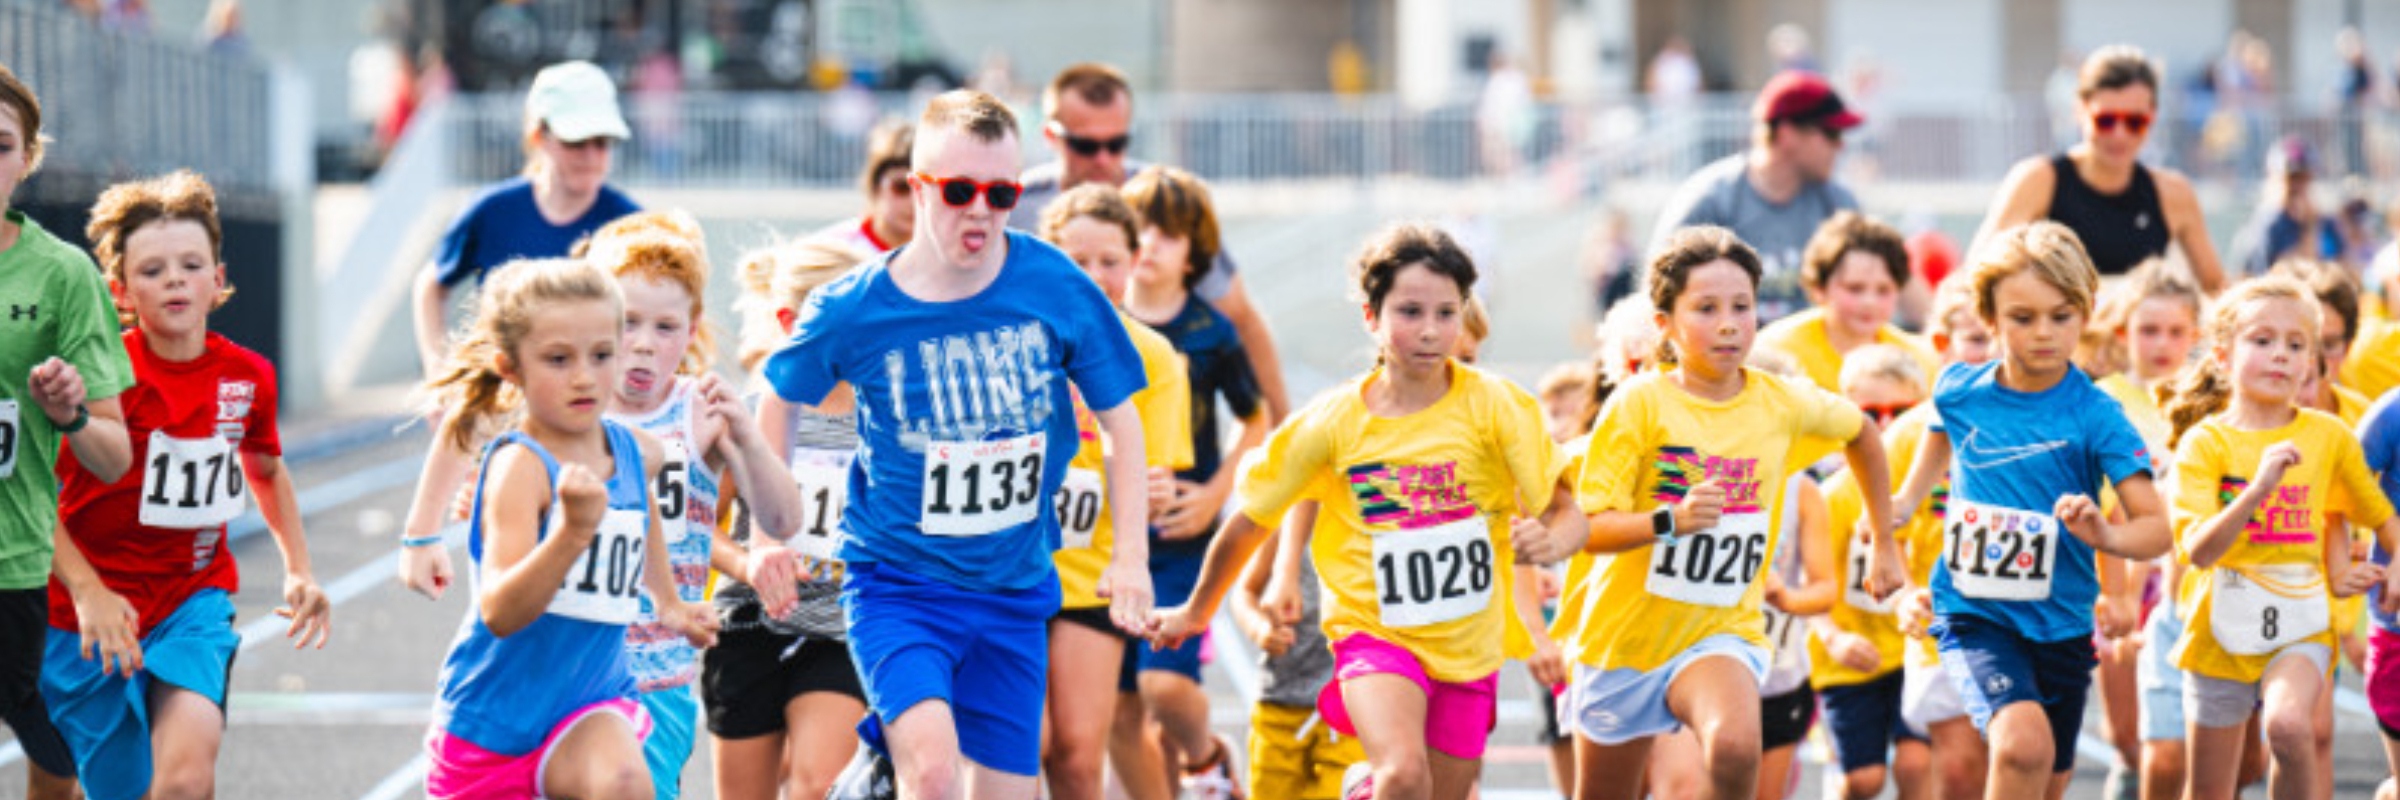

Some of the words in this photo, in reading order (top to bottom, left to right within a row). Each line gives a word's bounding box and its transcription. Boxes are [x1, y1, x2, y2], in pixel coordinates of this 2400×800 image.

[886, 320, 1052, 452] LIONS
[147, 452, 243, 508] 1176
[657, 461, 684, 520] 5
[927, 452, 1042, 515] 1133
[560, 533, 645, 598] 102
[1378, 537, 1492, 605] 1028
[1655, 532, 1766, 585] 1026
[1948, 521, 2048, 581] 1121
[2262, 605, 2279, 641] 8
